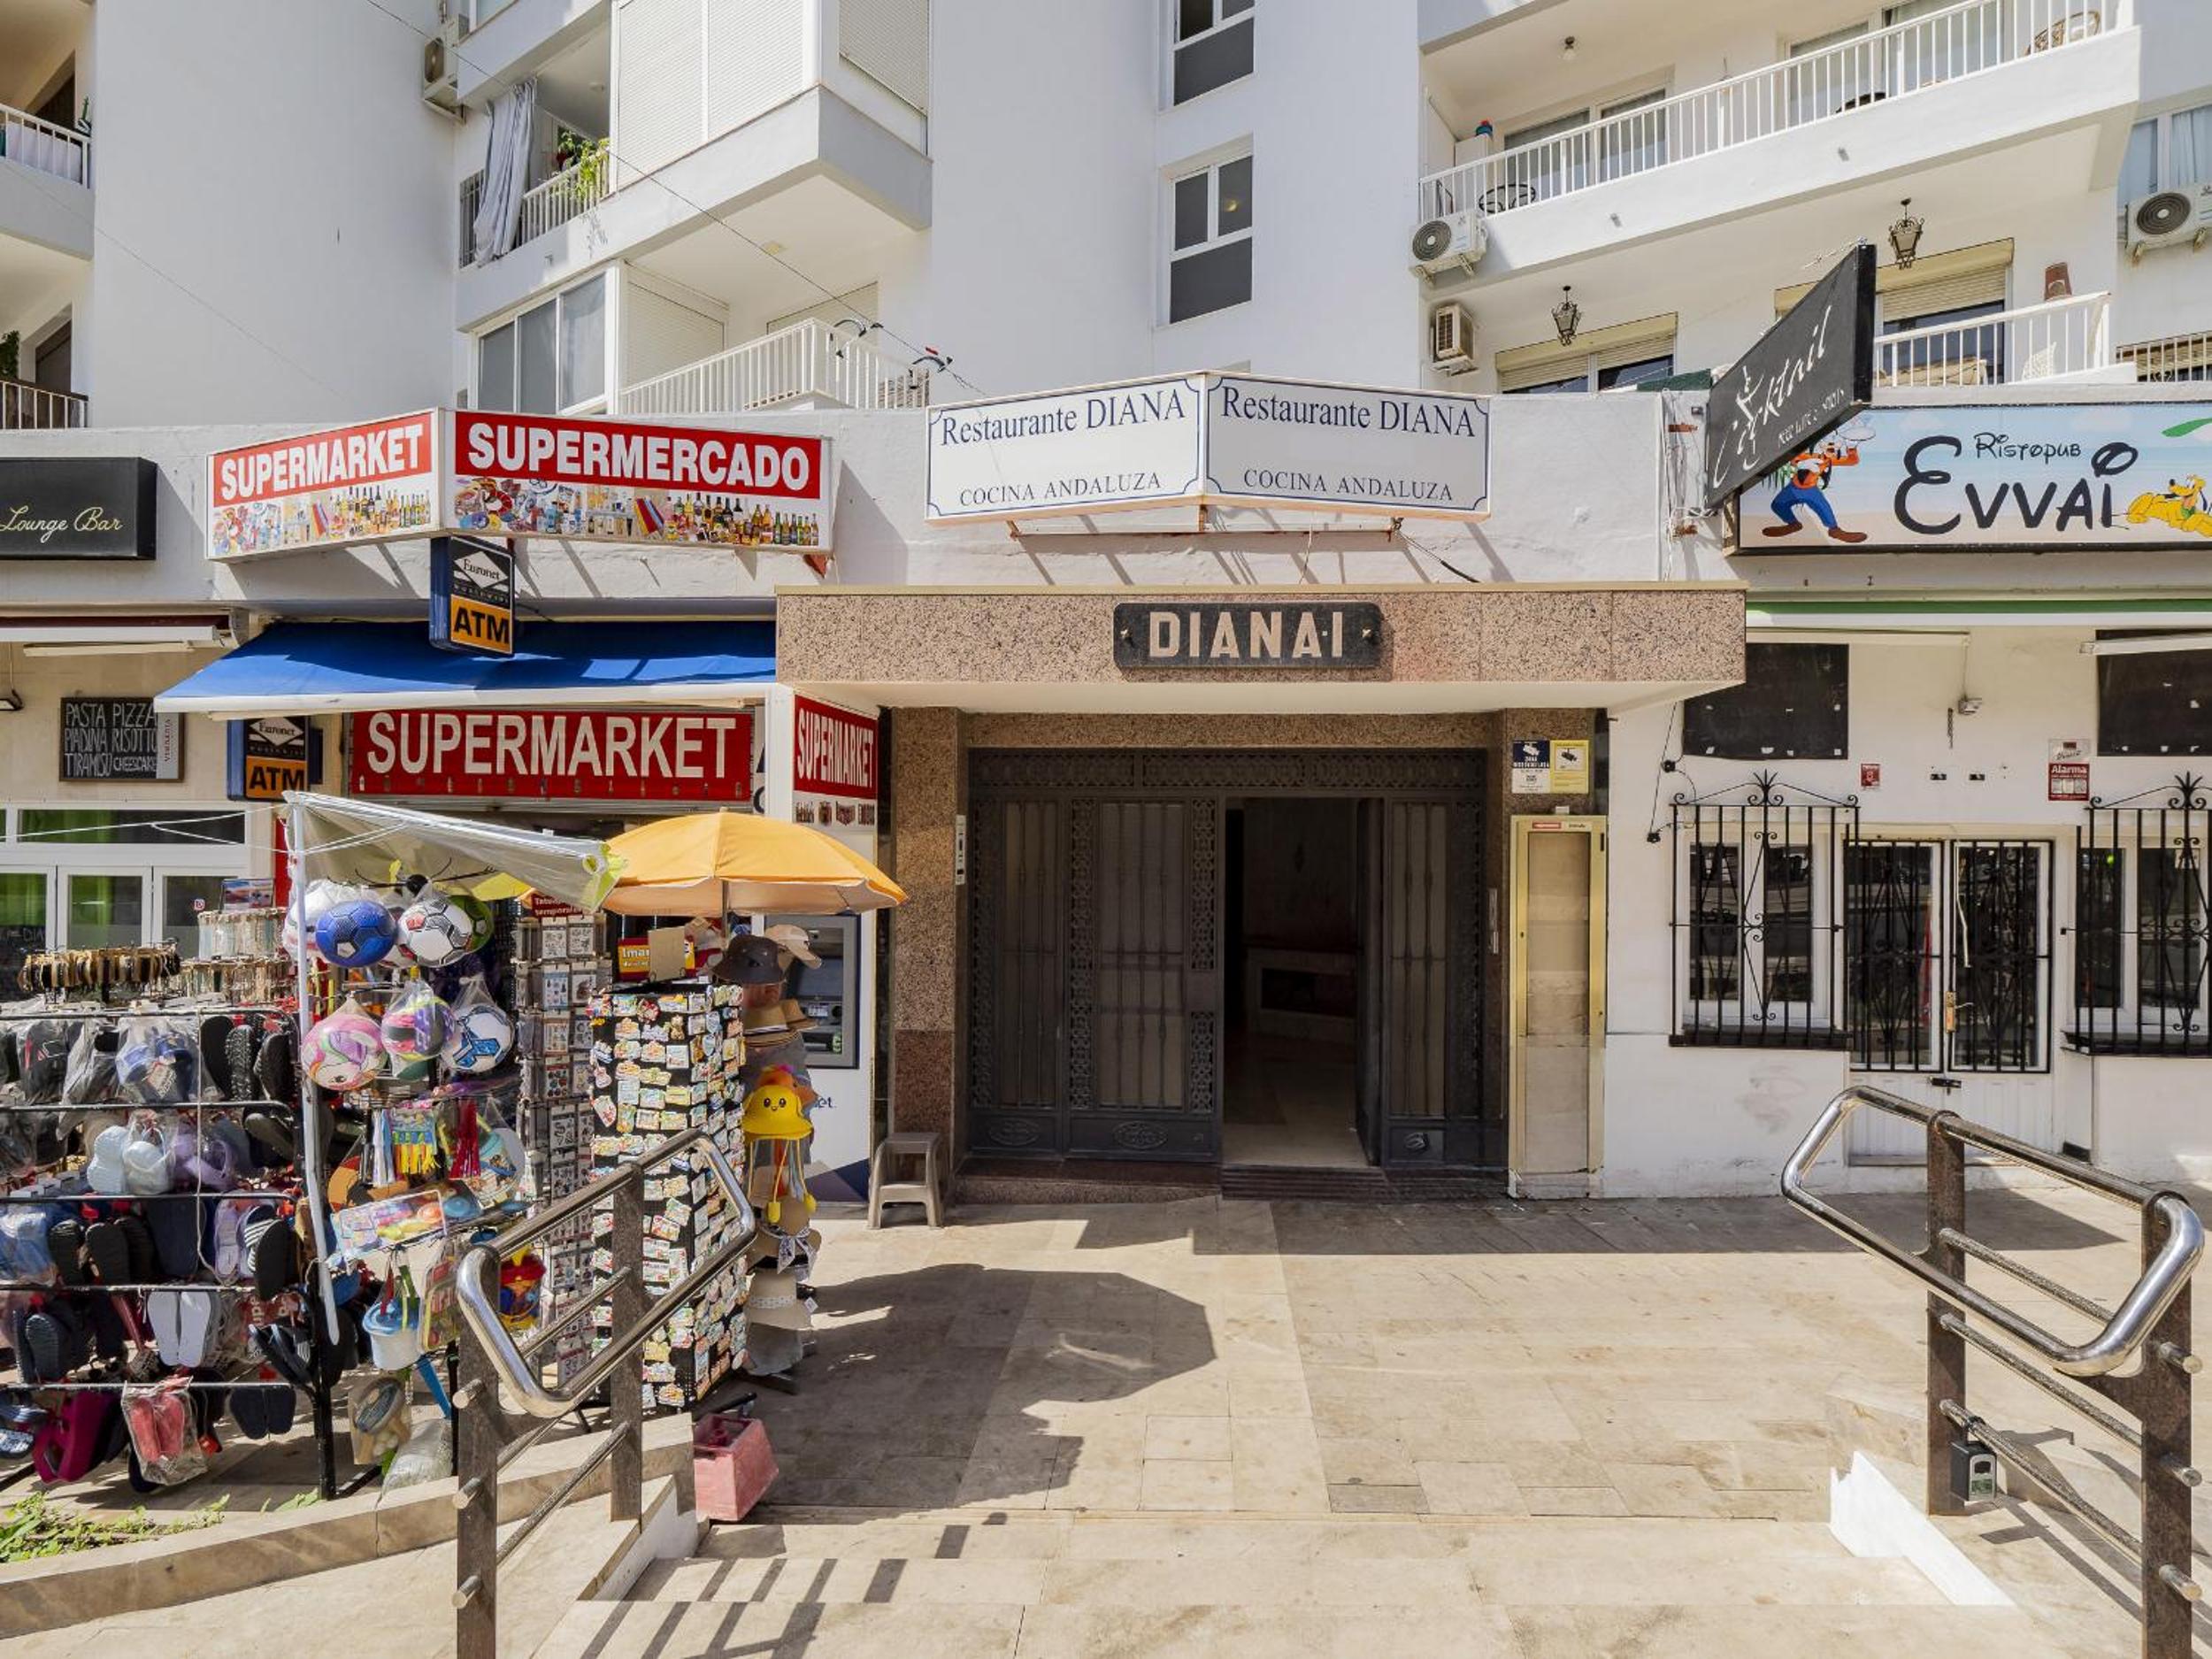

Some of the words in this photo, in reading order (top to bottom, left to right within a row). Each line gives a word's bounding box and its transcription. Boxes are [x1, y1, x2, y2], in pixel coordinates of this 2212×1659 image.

[940, 409, 1078, 447] Restaurante
[1086, 388, 1186, 428] DIANA
[1221, 385, 1371, 428] Restaurante
[1379, 400, 1476, 438] DIANA
[220, 423, 424, 502] SUPERMARKET
[468, 422, 810, 490] SUPERMERCADO
[959, 483, 1035, 507] COCINA
[1043, 471, 1162, 499] ANDALUZA
[1243, 468, 1328, 493] COCINA
[1335, 476, 1454, 502] ANDALUZA
[0, 505, 69, 544] Lounge
[73, 506, 124, 532] Bar
[463, 557, 501, 580] Euronet
[454, 606, 511, 645] ATM
[65, 703, 107, 728] PASTA
[111, 703, 158, 728] PIZZA
[367, 711, 736, 779] SUPERMARKET
[797, 708, 874, 789] SUPERMARKET
[249, 765, 305, 792] ATM
[2051, 764, 2088, 774] Alarma
